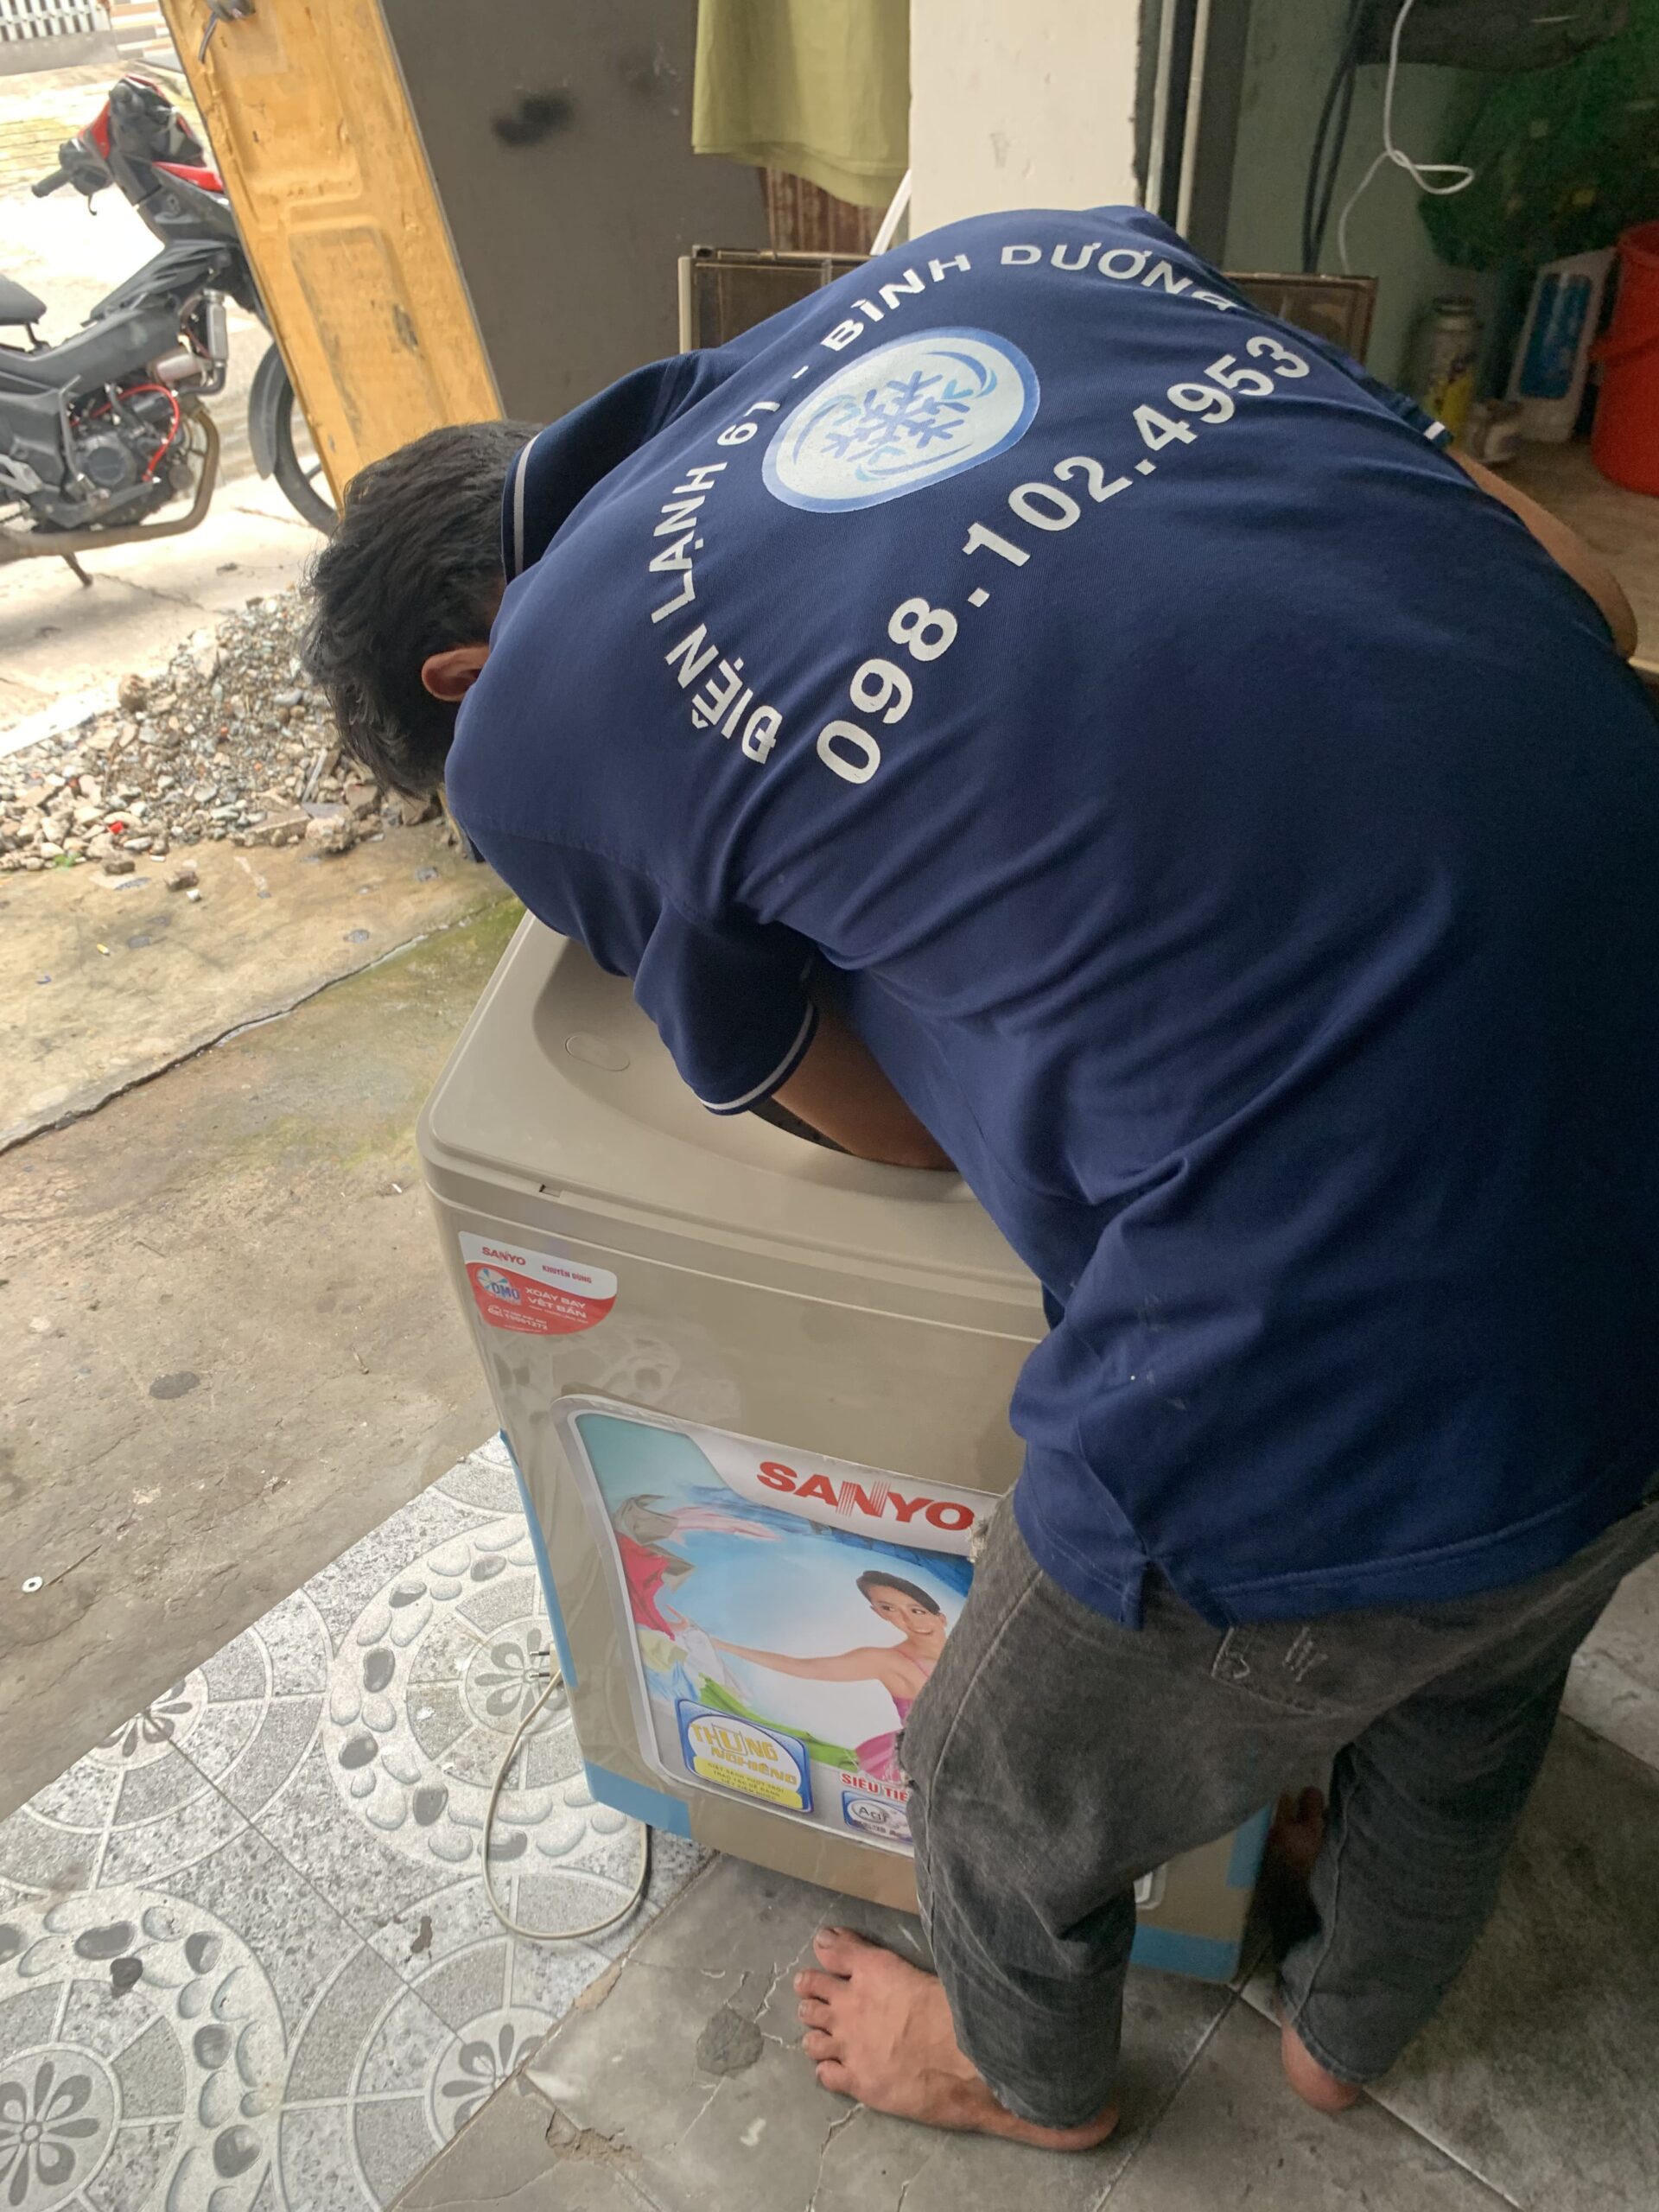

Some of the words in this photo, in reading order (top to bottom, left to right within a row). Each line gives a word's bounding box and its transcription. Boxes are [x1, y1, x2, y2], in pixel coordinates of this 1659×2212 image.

[822, 251, 974, 352] BÌNH
[717, 400, 780, 447] 61
[649, 461, 728, 624] LẠNH
[817, 335, 1310, 785] 098.102.4953
[664, 623, 783, 764] ĐIỆN
[482, 1246, 526, 1266] SANYO
[491, 1281, 520, 1300] OMO
[757, 1461, 975, 1530] SANYO
